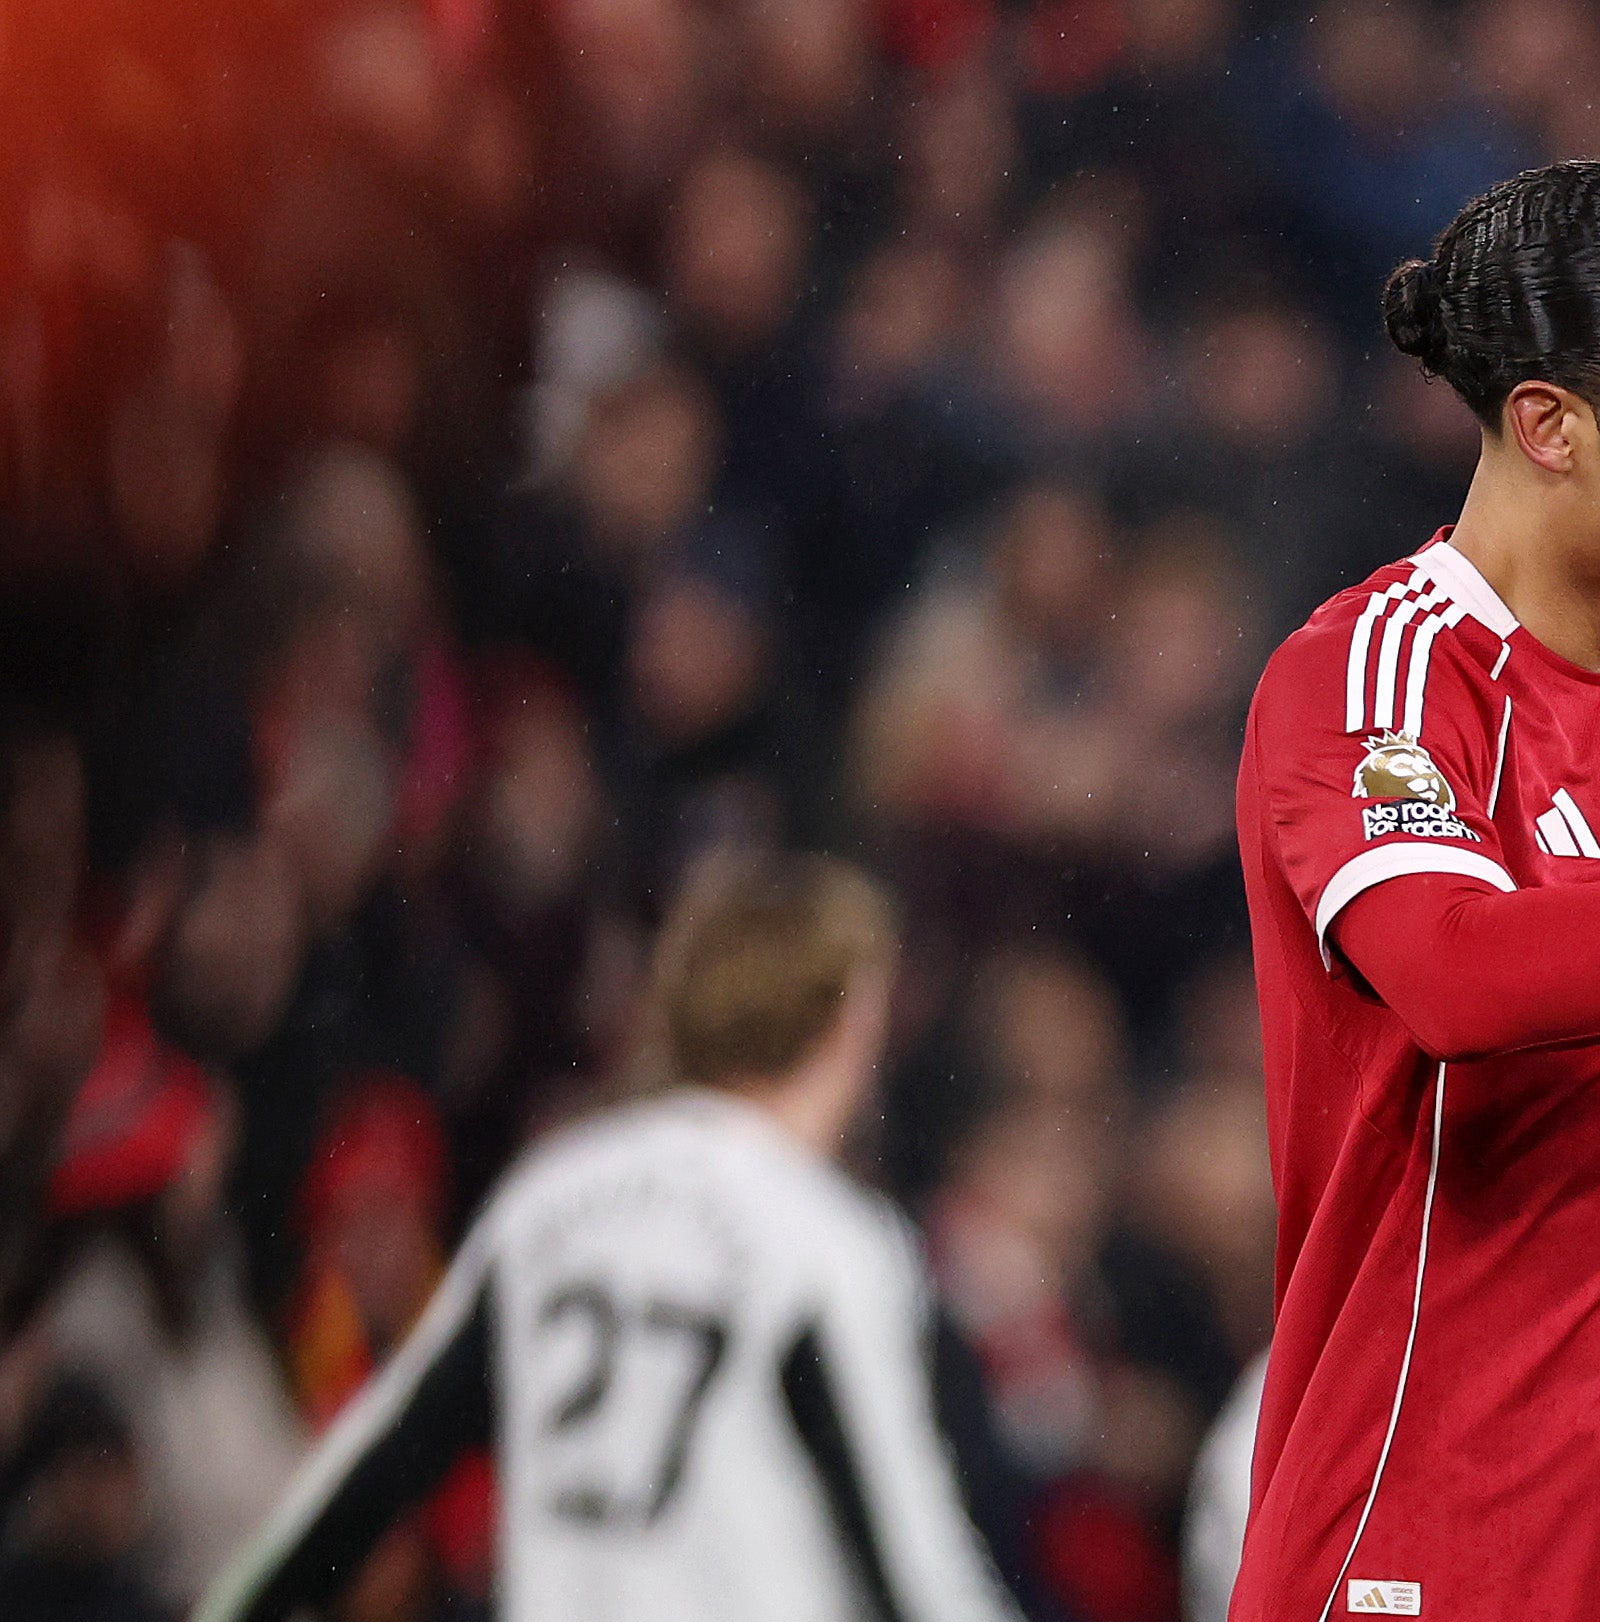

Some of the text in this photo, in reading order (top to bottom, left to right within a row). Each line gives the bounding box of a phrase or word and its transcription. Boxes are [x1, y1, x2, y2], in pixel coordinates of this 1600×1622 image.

[1362, 803, 1399, 824] No
[1364, 820, 1481, 842] for racism
[533, 1279, 731, 1531] 27
